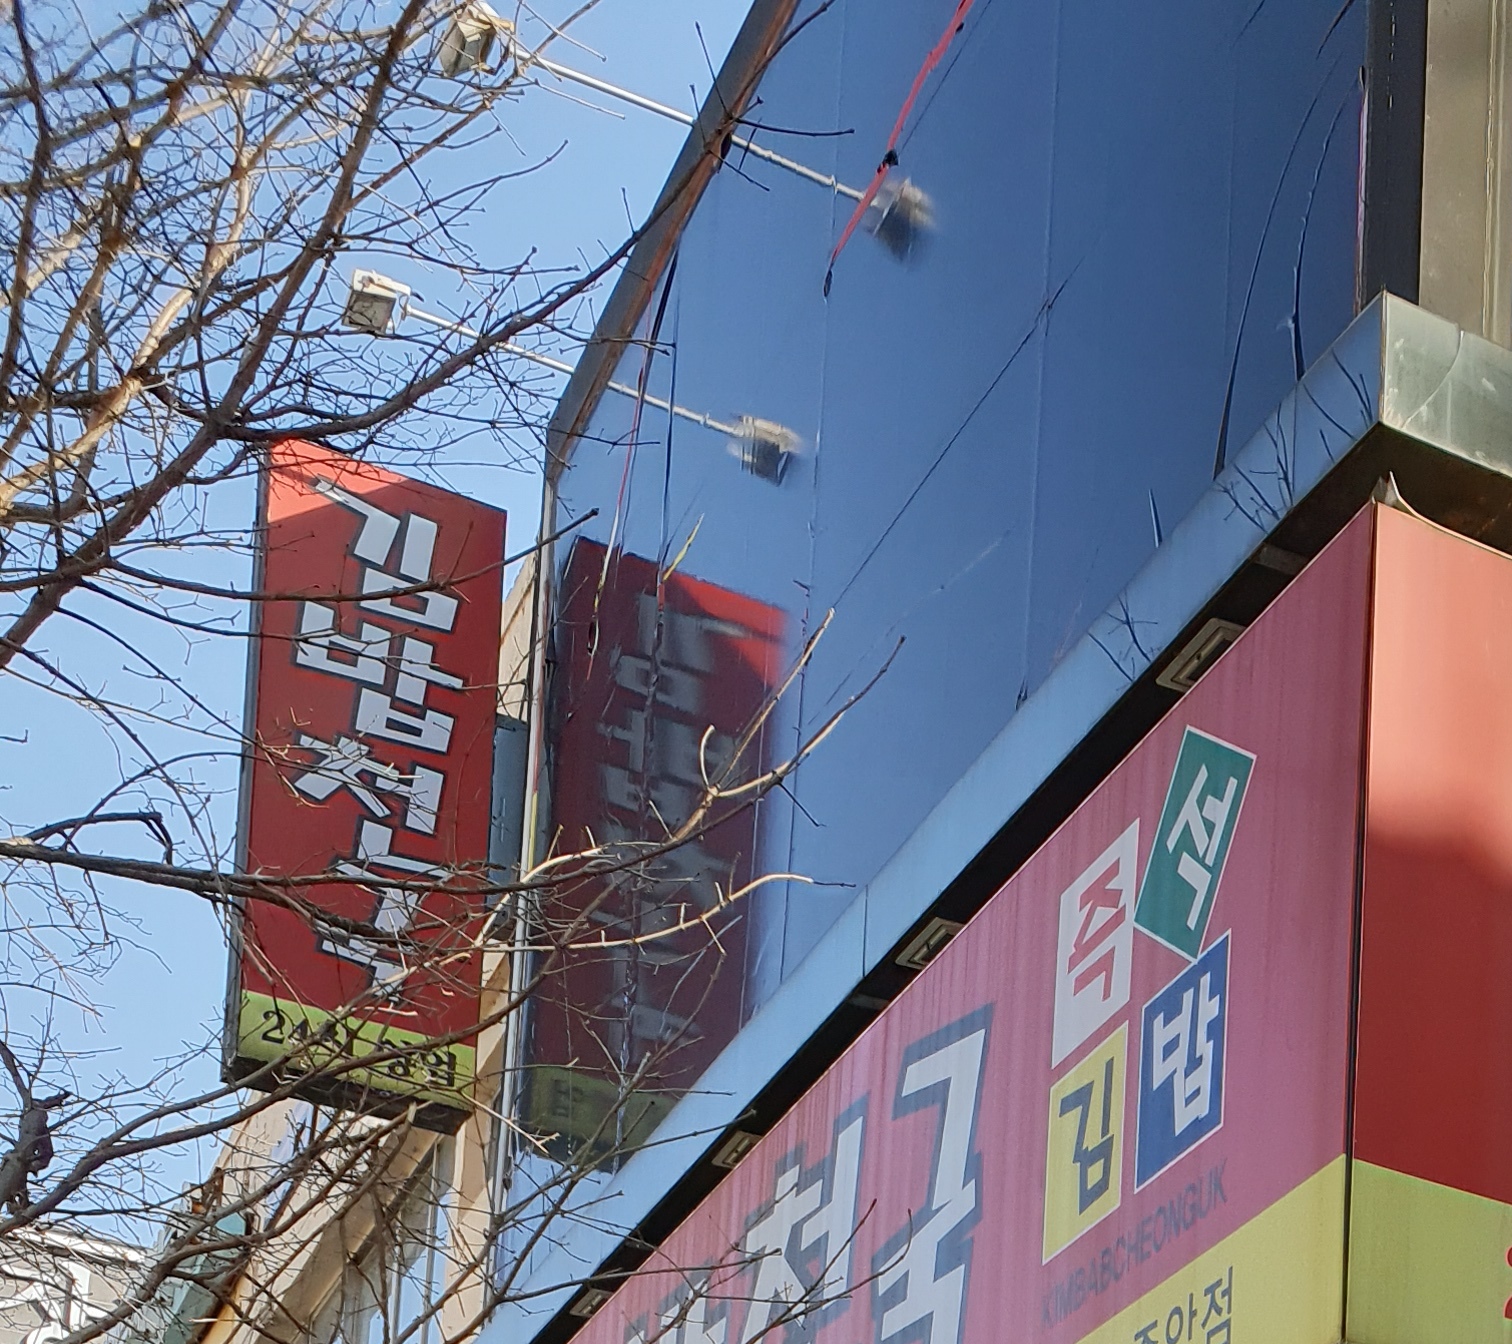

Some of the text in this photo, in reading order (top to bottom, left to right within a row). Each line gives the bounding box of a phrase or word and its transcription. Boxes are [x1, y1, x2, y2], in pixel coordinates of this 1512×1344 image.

[293, 474, 482, 1002] 김밥천국
[1068, 763, 1239, 1002] 즉석
[1058, 975, 1221, 1217] 김밥
